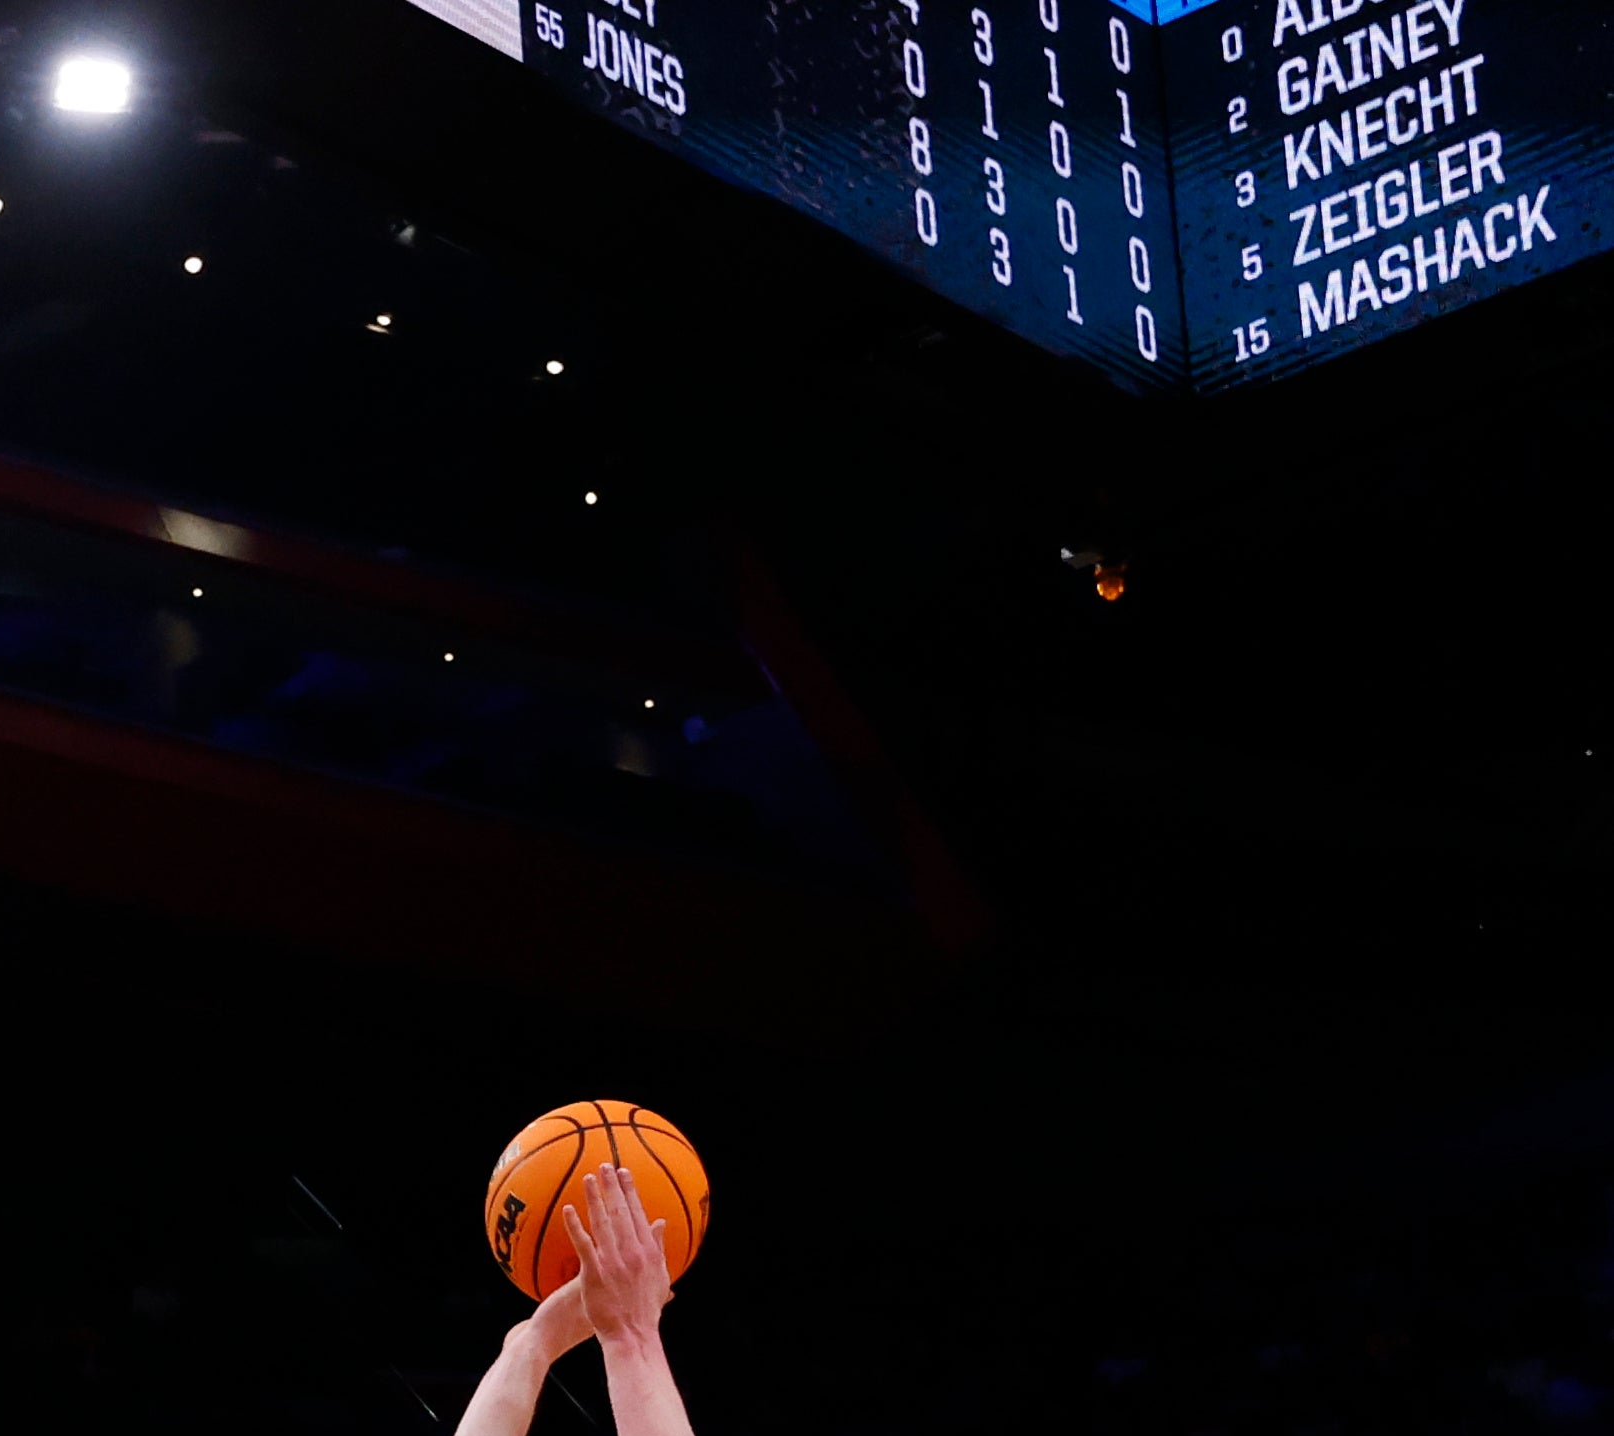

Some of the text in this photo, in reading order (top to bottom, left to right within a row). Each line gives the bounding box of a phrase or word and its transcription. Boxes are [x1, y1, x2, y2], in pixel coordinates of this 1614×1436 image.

[970, 8, 994, 68] 3
[1043, 46, 1065, 109] 1
[1115, 88, 1137, 149] 1
[1108, 16, 1132, 75] 0
[1221, 25, 1243, 63] 0
[1227, 0, 1464, 134] 2 GAINEY
[536, 2, 565, 51] 55
[583, 12, 686, 116] JONES
[914, 187, 938, 247] 0
[989, 227, 1013, 287] 3
[1062, 264, 1084, 326] 1
[1135, 305, 1158, 363] 0
[903, 38, 1144, 219] 0 1 0 0
[909, 115, 1151, 294] 8 3 0 0
[1235, 53, 1484, 208] 3 KNECHT
[1242, 129, 1505, 281] 5 ZEIGLER
[1232, 184, 1557, 363] 15 MASHACK
